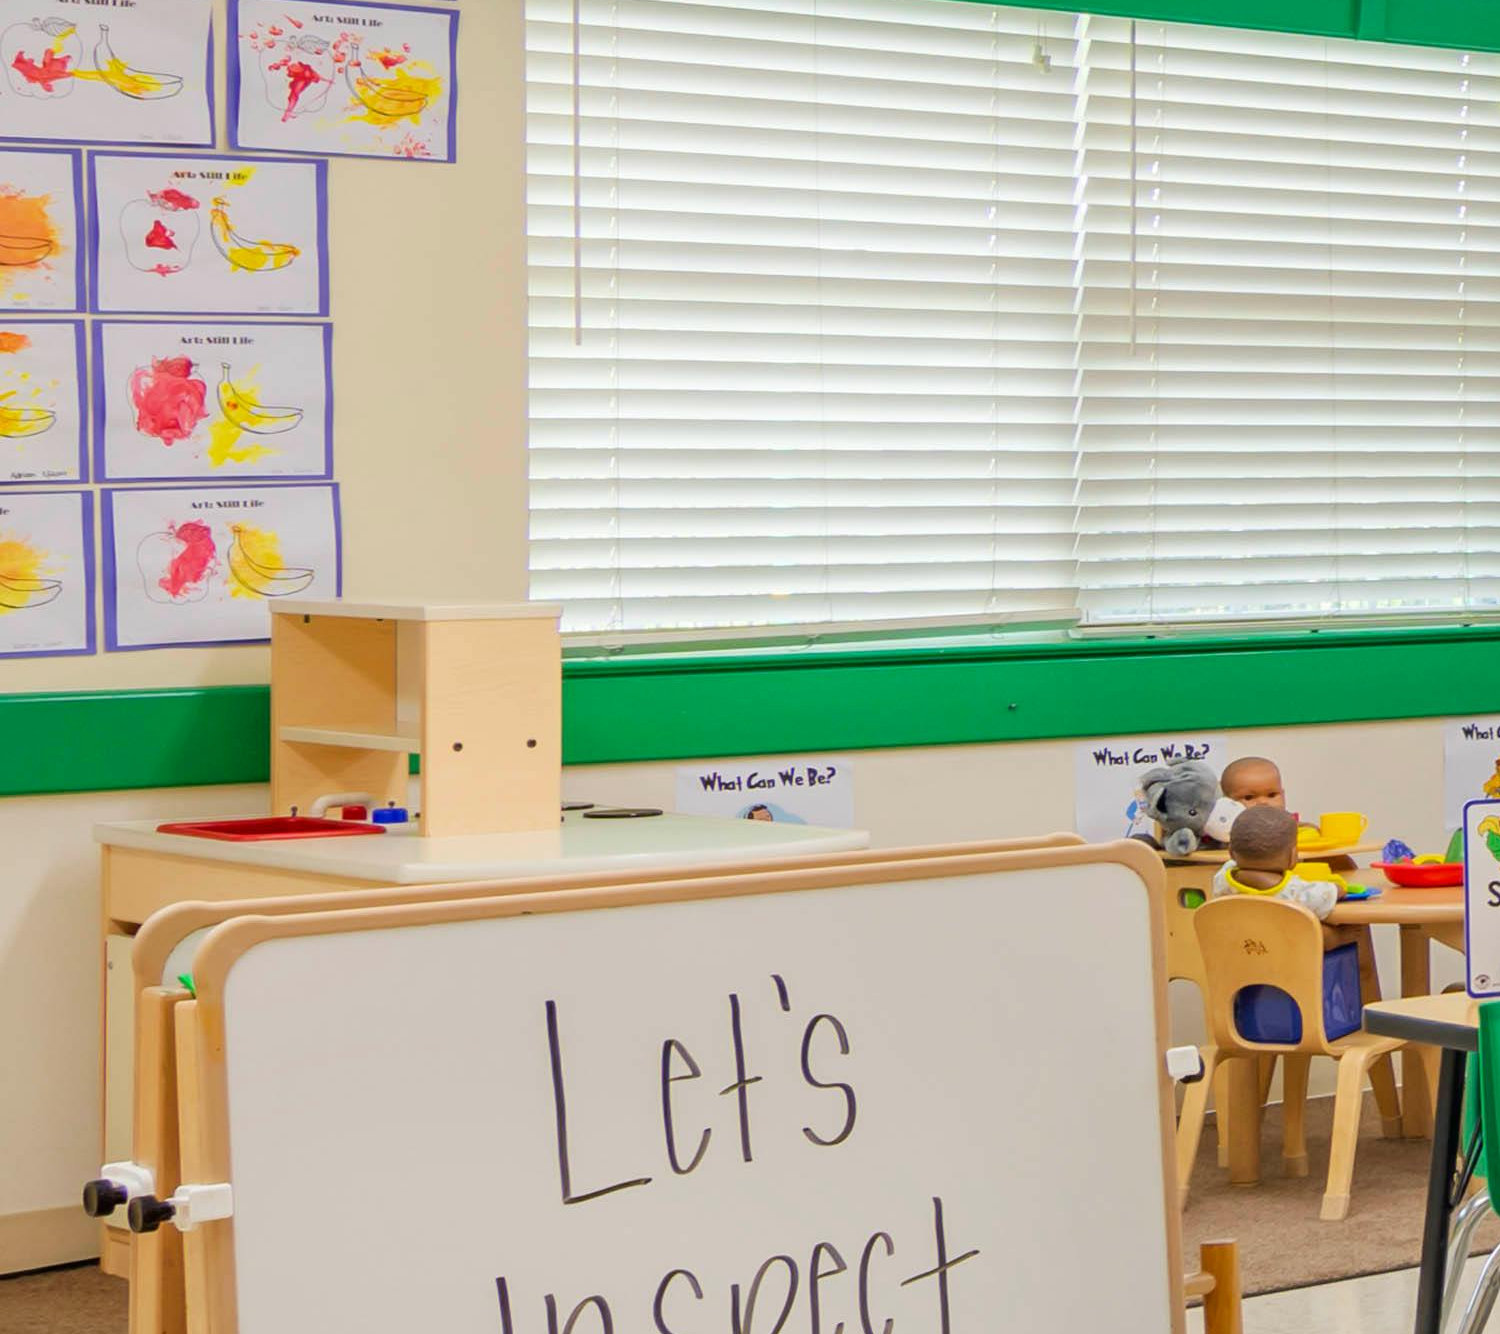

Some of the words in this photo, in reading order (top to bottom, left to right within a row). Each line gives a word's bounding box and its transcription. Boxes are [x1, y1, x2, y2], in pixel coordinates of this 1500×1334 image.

[336, 15, 360, 26] Still
[362, 17, 384, 28] Life
[199, 170, 224, 181] Still
[206, 335, 230, 346] Still
[232, 336, 255, 347] Life
[216, 499, 241, 510] Still
[243, 498, 266, 509] Life
[1461, 722, 1494, 741] What
[1092, 746, 1130, 766] What
[1132, 747, 1158, 765] Can
[1183, 742, 1210, 761] Be?
[699, 771, 743, 792] What
[746, 771, 776, 790] Can
[778, 766, 804, 787] We
[806, 766, 837, 787] Be?
[544, 972, 858, 1207] Let's
